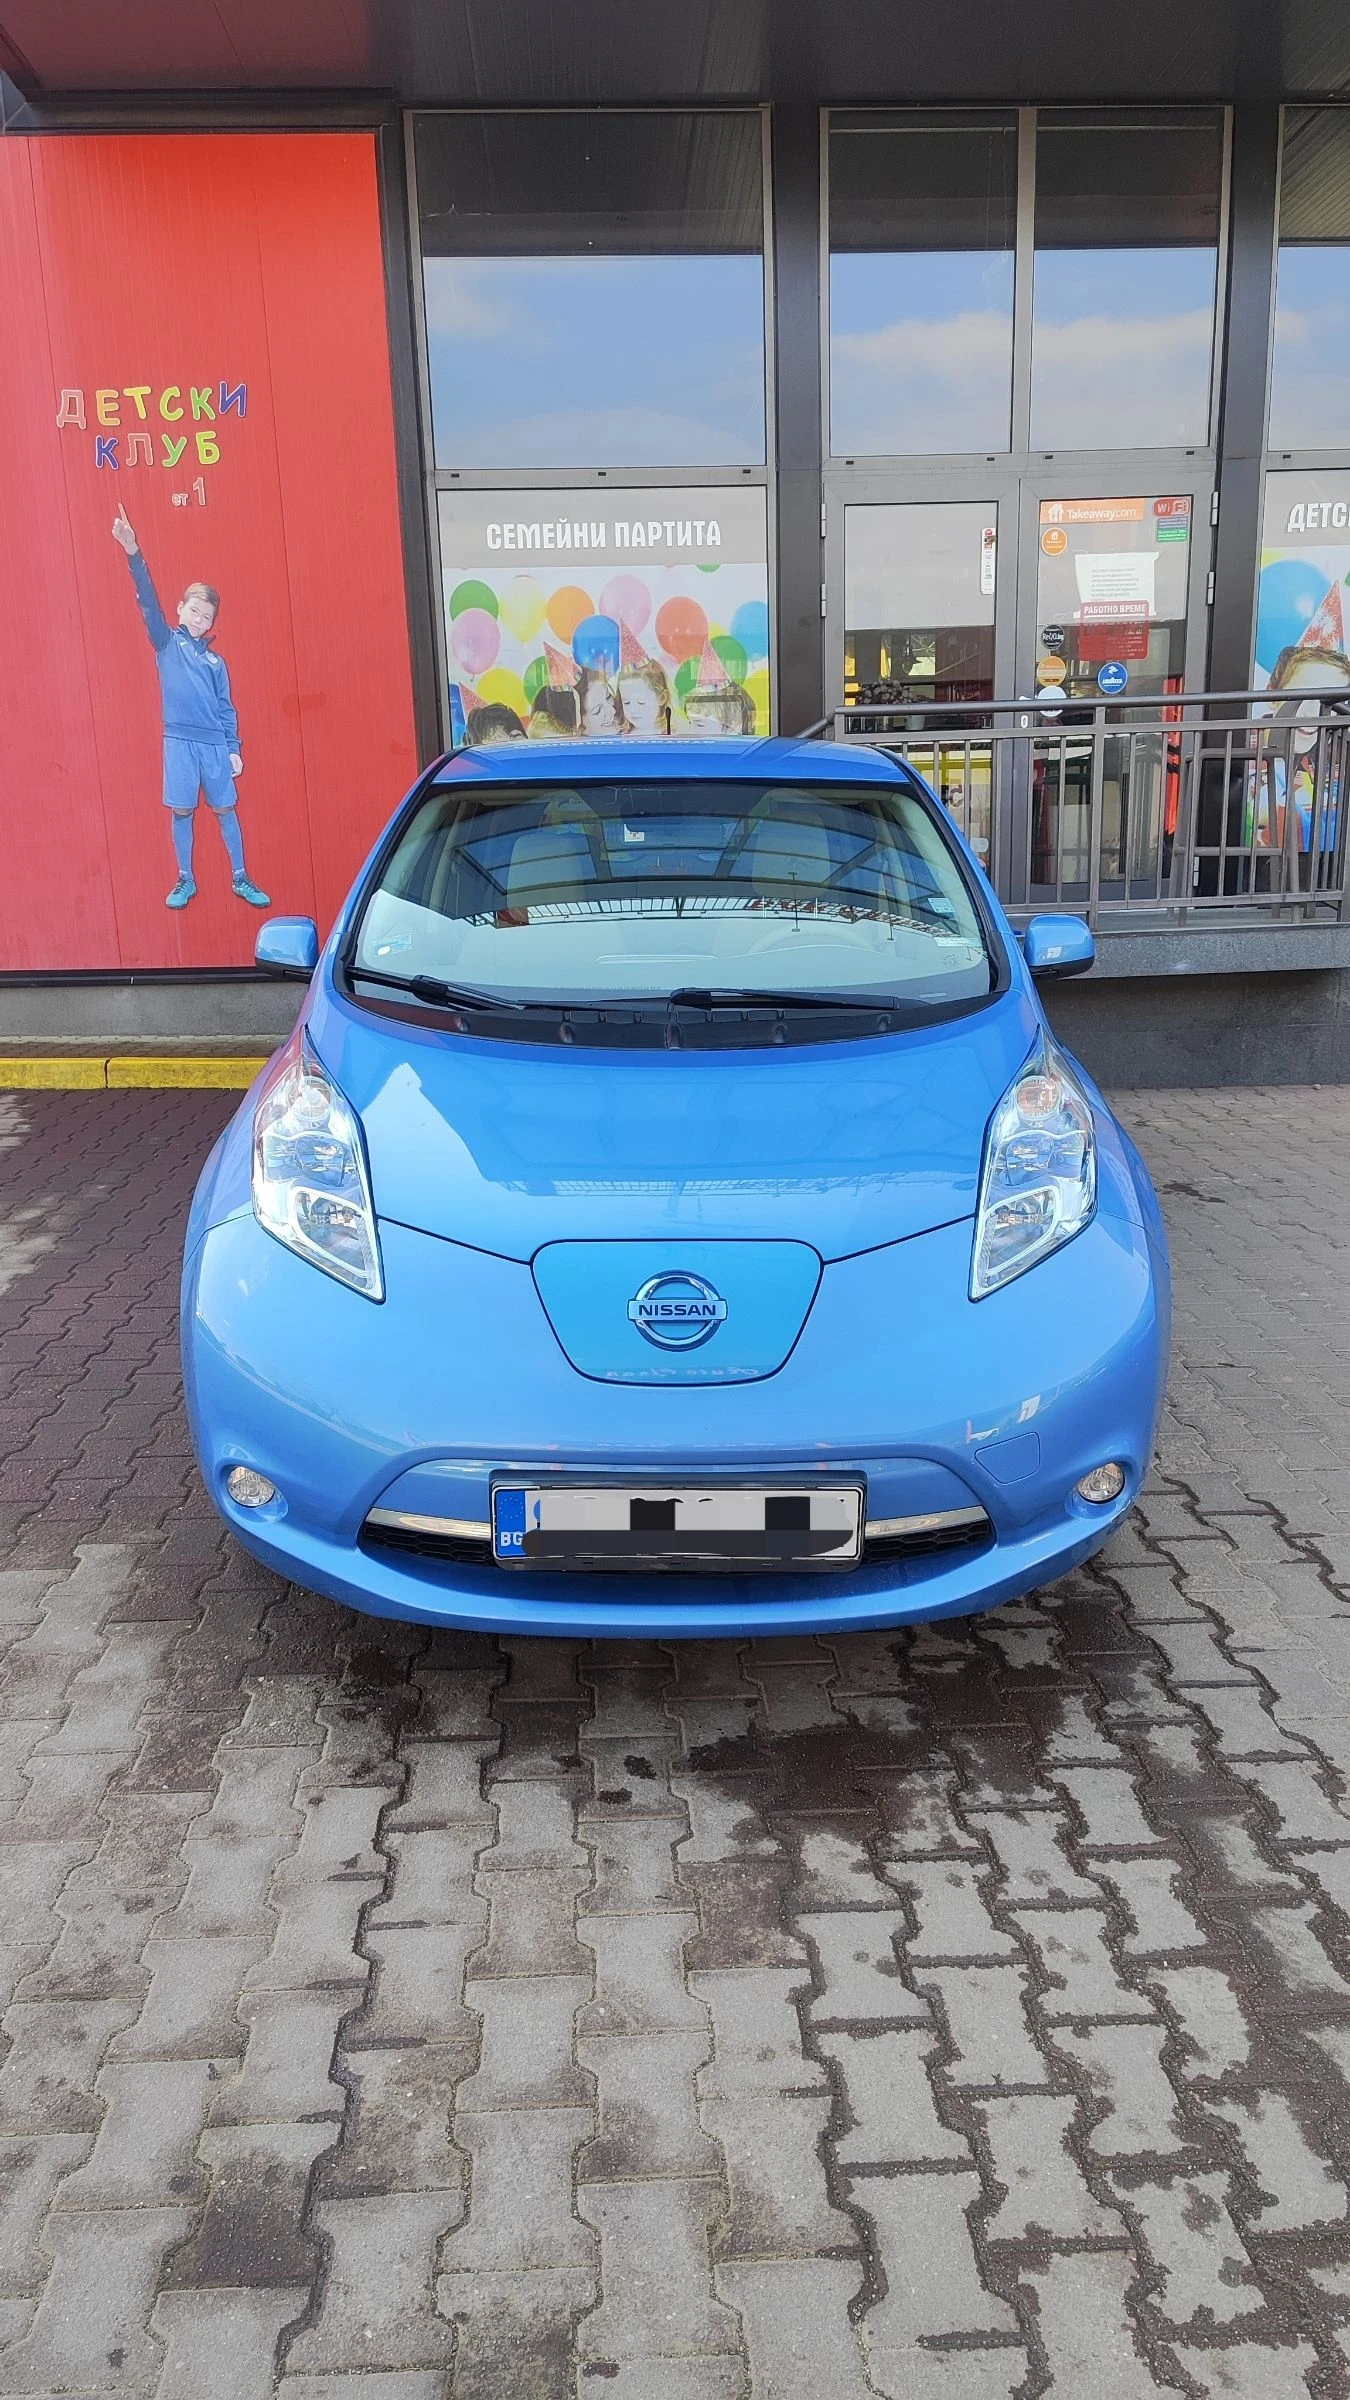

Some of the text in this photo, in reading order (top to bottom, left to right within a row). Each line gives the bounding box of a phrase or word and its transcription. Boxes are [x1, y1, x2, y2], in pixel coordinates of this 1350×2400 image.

[57, 381, 247, 430] ДЕТСКИ
[96, 430, 221, 470] КЛУБ
[193, 477, 206, 506] 1
[1067, 508, 1137, 520] Takeaway.com
[1287, 502, 1350, 533] ДЕТС
[486, 518, 721, 550] СЕМЕЙНИ ПАРТИТА
[1083, 604, 1147, 615] РАБОТНО ВРЕМЕ
[638, 1304, 717, 1317] NISSAN
[501, 1531, 524, 1547] BG
